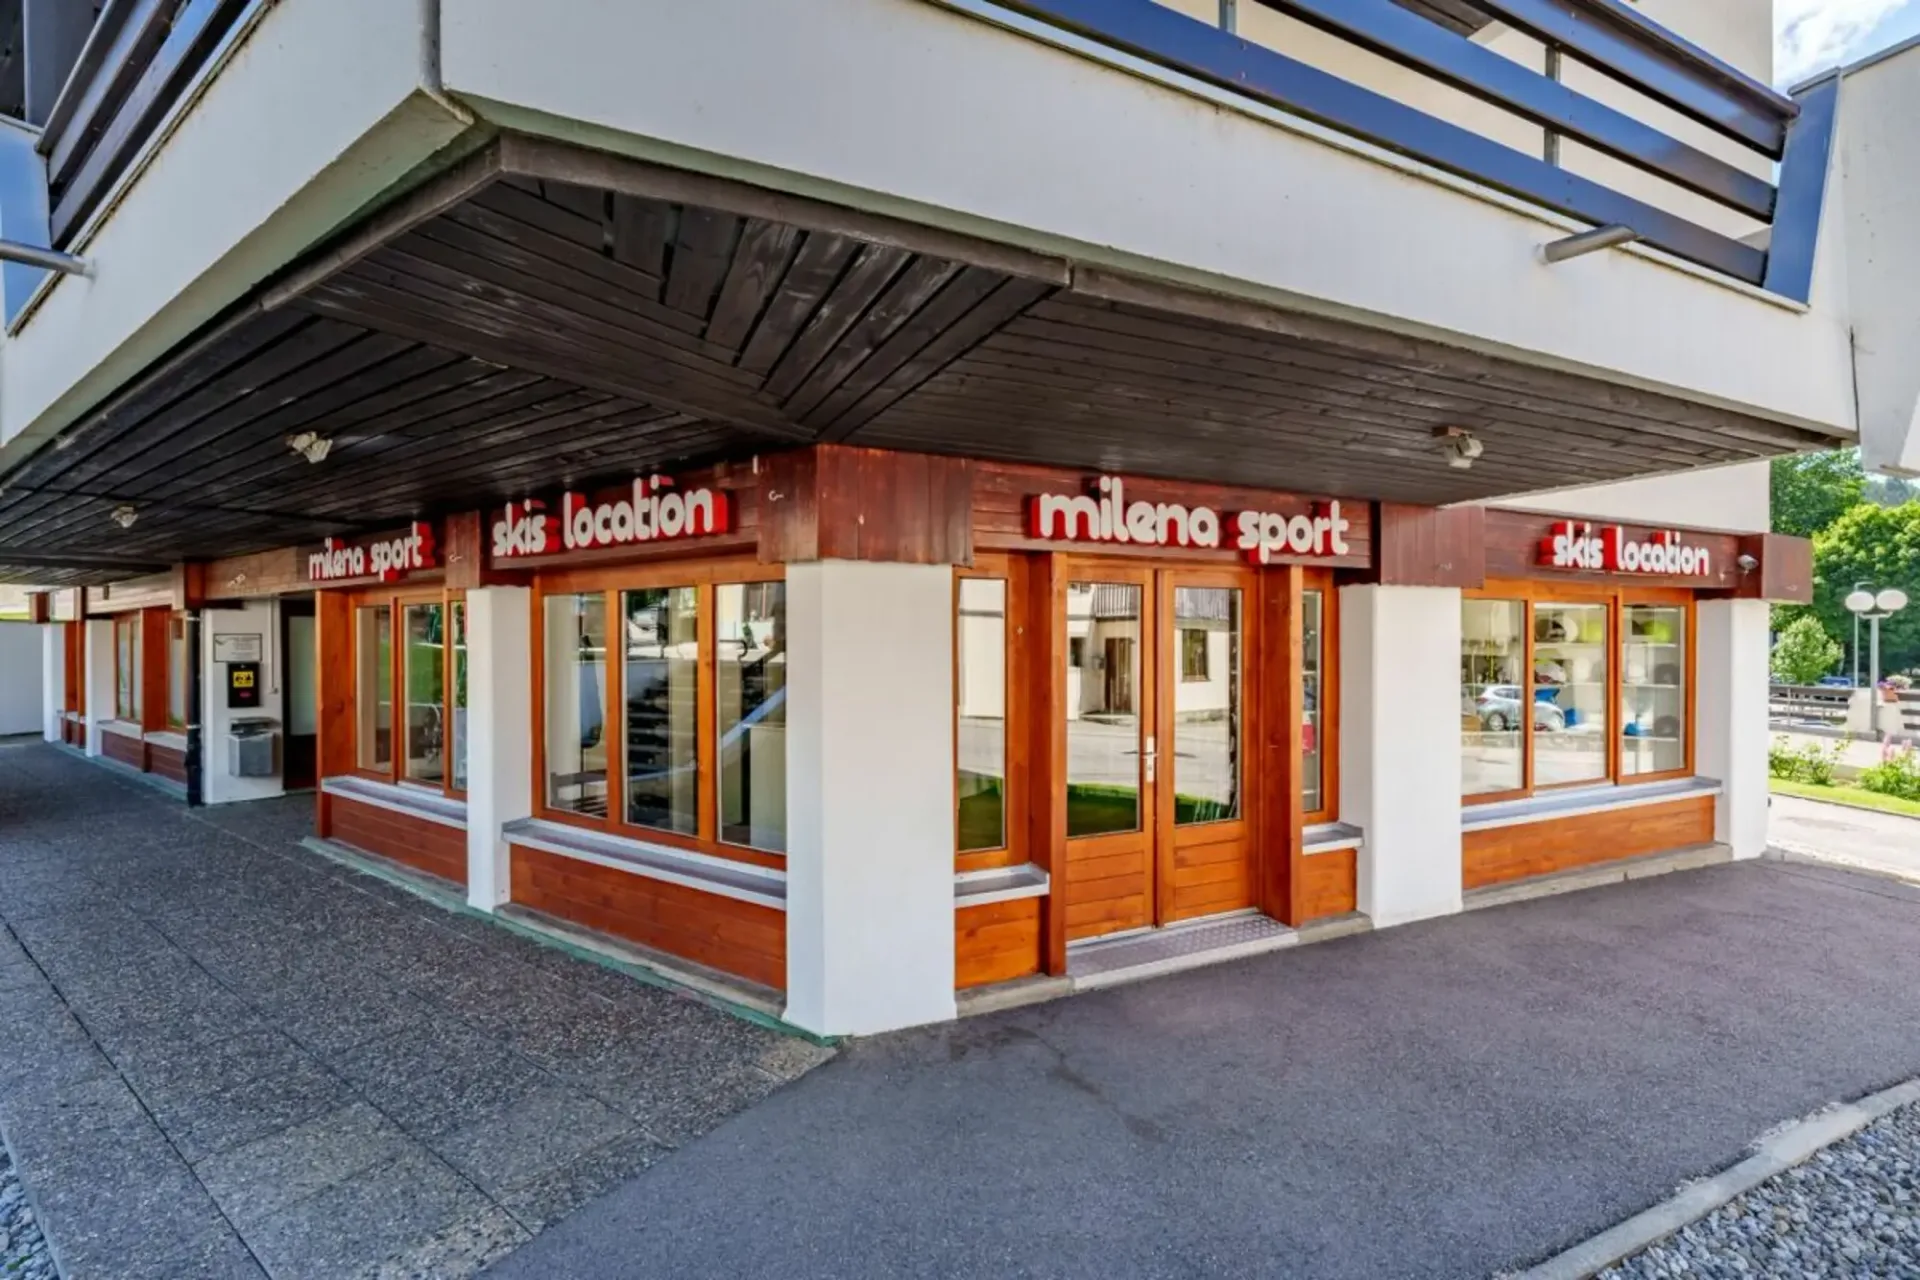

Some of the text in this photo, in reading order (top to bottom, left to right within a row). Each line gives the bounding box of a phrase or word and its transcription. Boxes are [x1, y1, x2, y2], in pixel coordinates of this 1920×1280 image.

[492, 474, 713, 556] skis location
[1039, 476, 1349, 563] milena sport
[1553, 520, 1710, 576] skis location
[309, 521, 423, 582] milena sport
